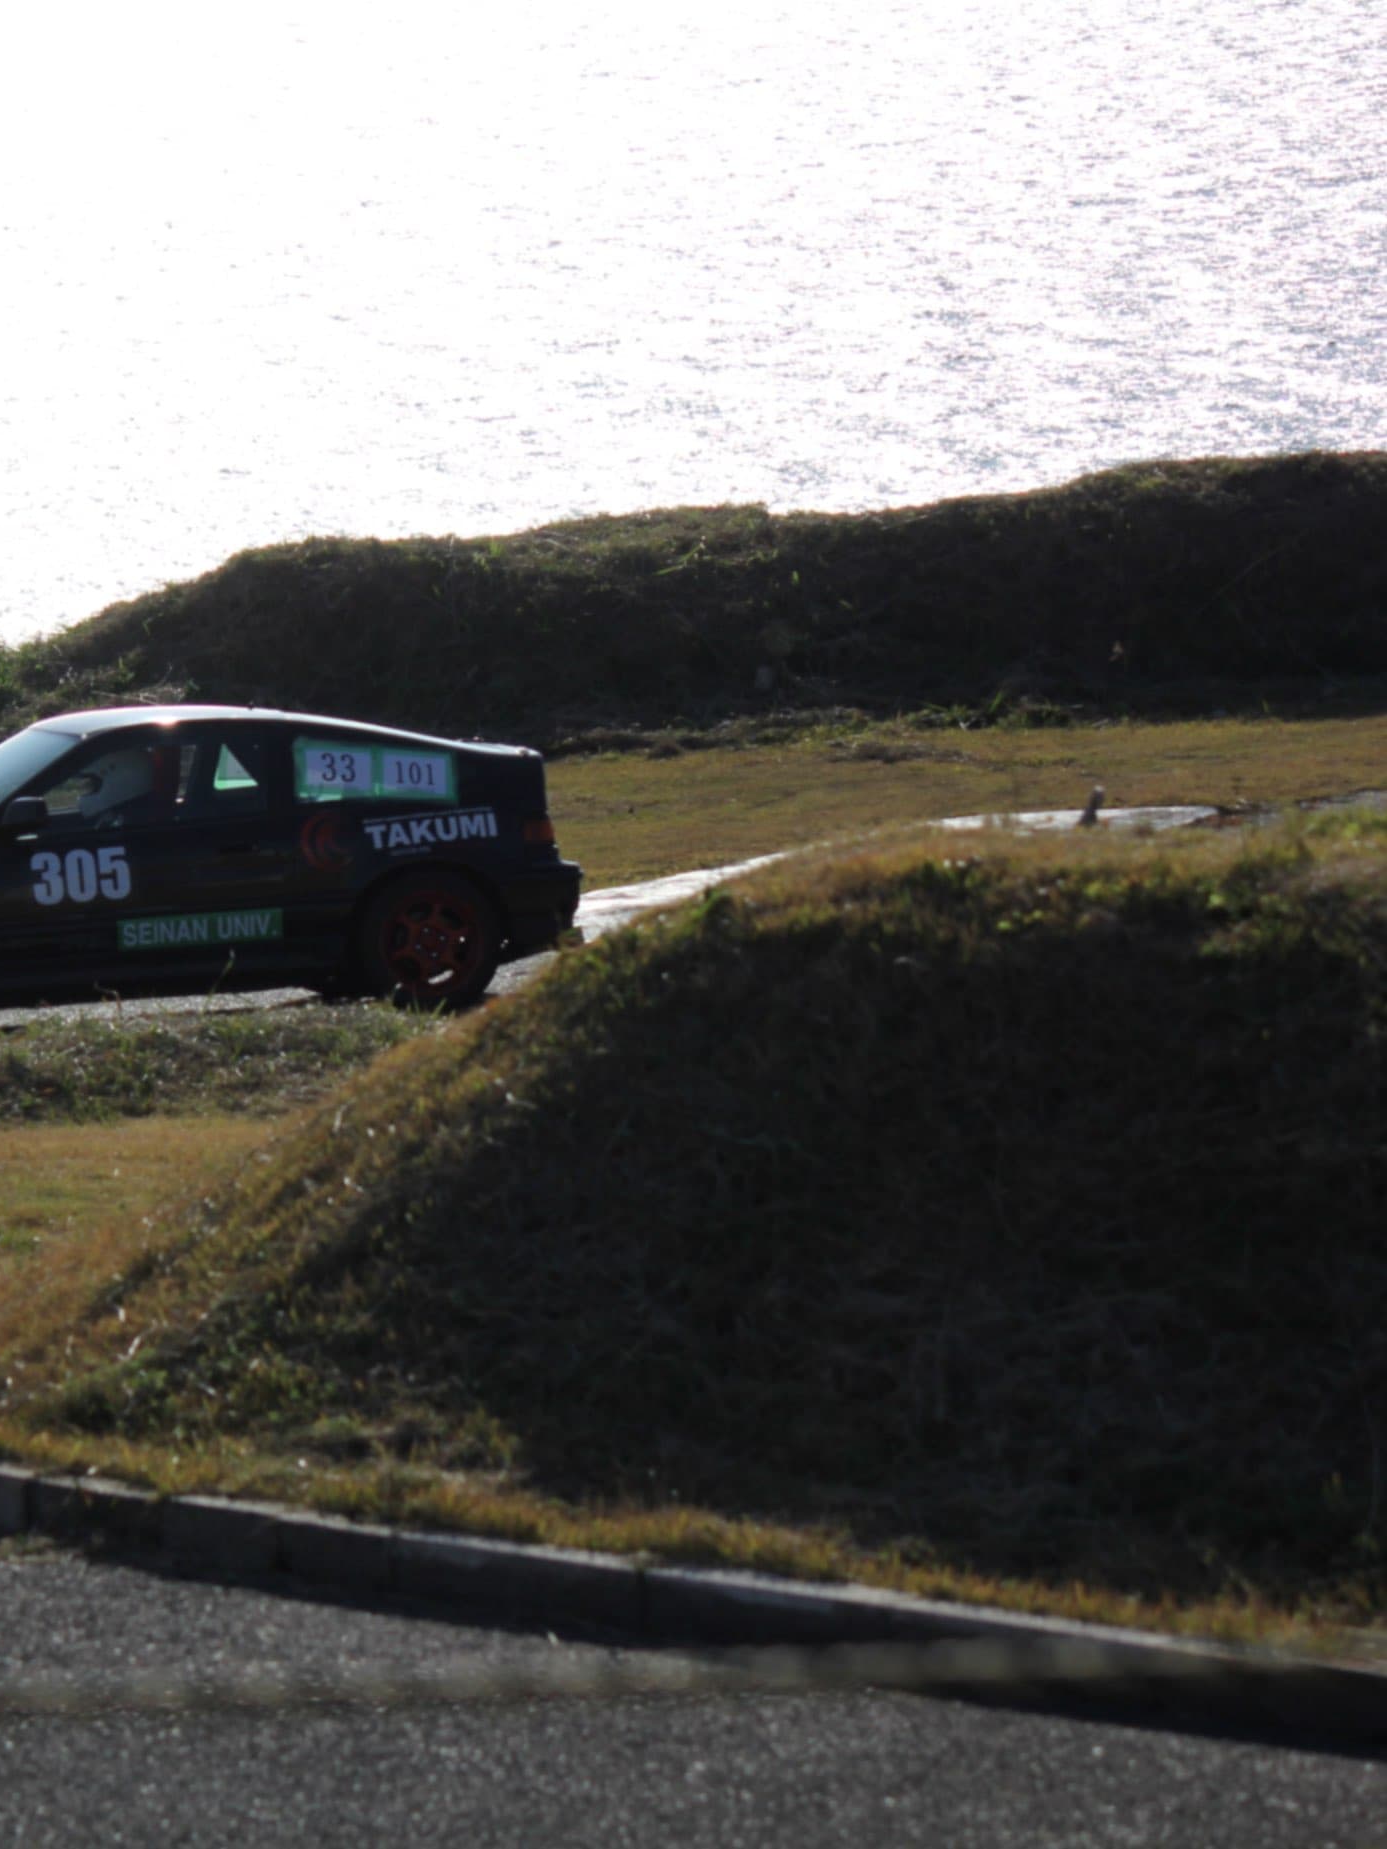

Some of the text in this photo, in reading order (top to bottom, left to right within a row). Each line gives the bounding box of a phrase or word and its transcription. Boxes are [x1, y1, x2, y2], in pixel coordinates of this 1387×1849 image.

[321, 752, 356, 783] 33
[396, 760, 436, 786] 101
[364, 812, 499, 850] TAKUMI
[30, 846, 132, 906] 305
[123, 912, 278, 947] SEINAN UNIV.
